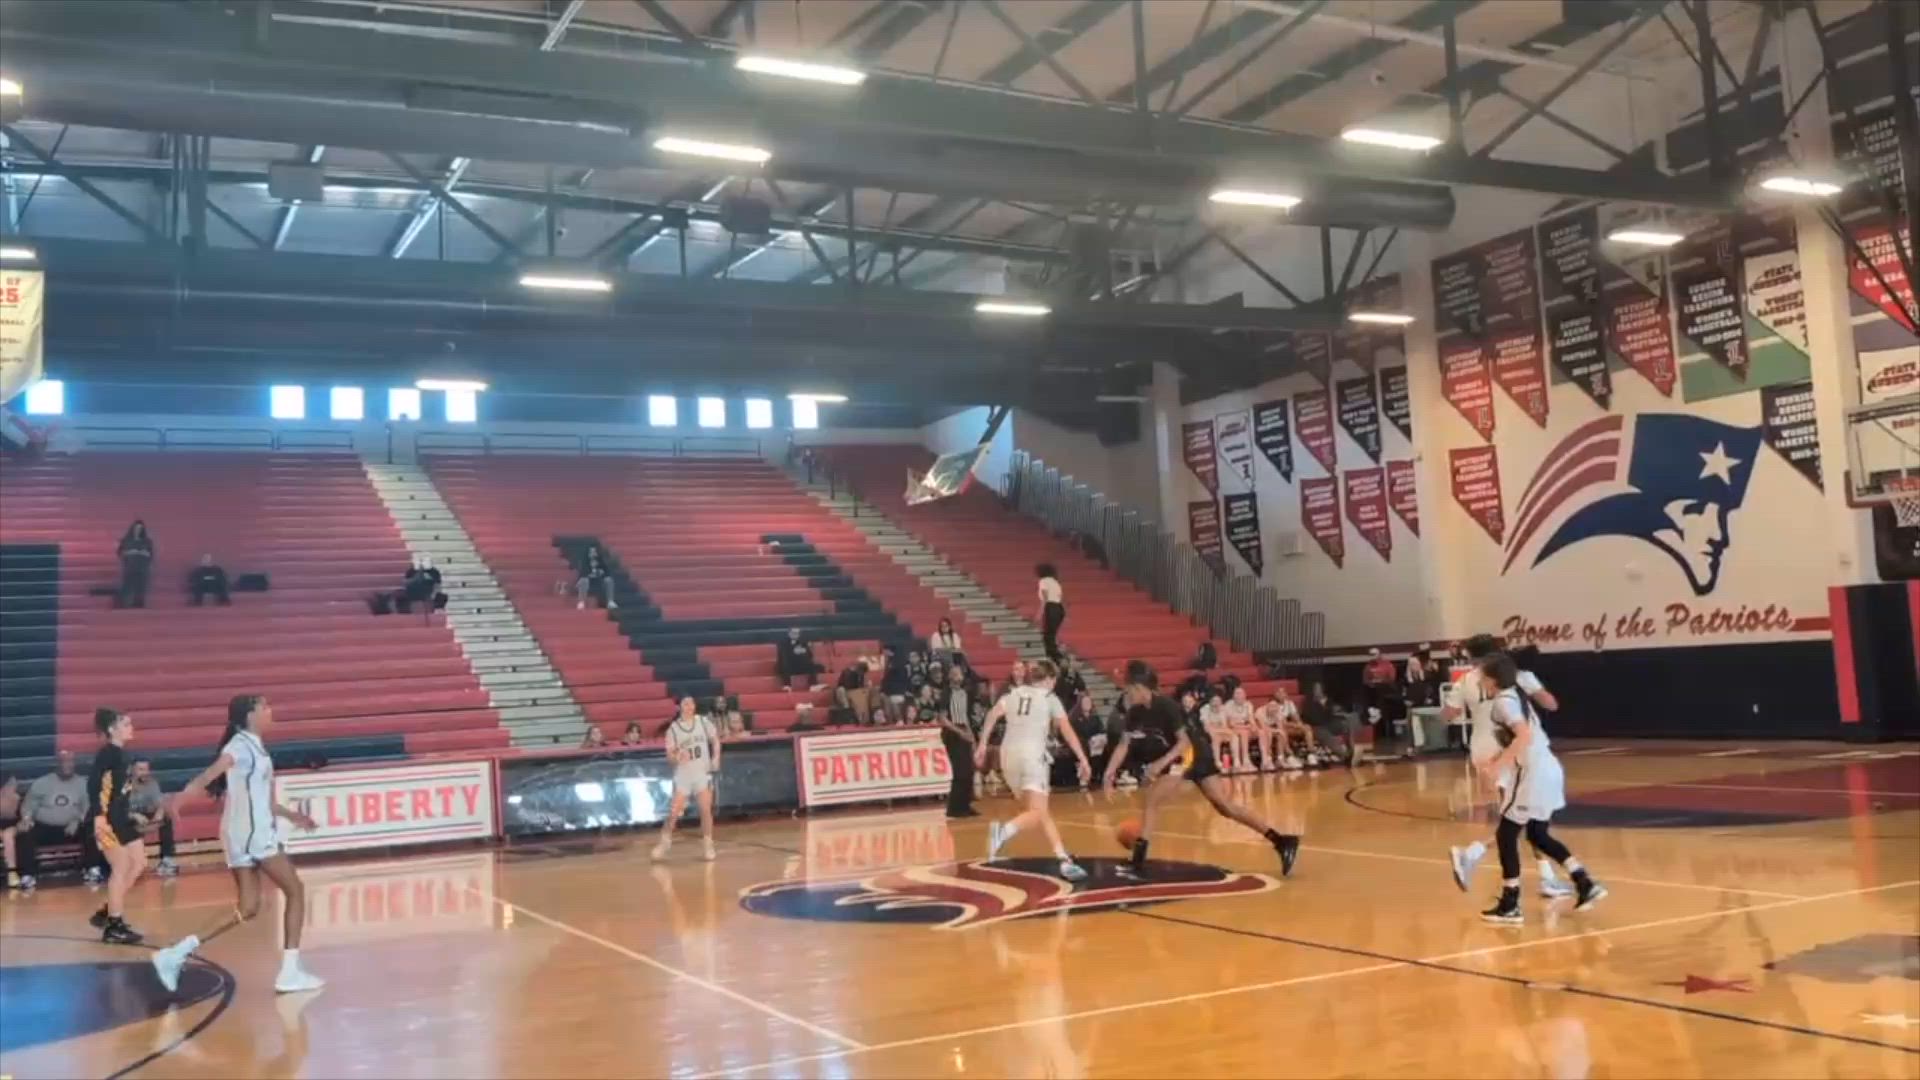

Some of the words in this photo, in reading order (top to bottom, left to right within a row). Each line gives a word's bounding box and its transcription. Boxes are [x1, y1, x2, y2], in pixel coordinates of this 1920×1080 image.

[1502, 614, 1575, 645] Home
[1582, 611, 1608, 650] of
[1615, 605, 1656, 640] the
[1665, 602, 1792, 636] Patriots
[1016, 695, 1033, 717] 11
[687, 744, 702, 761] 10
[809, 747, 948, 785] PATRIOTS
[325, 783, 481, 828] LIBERTY
